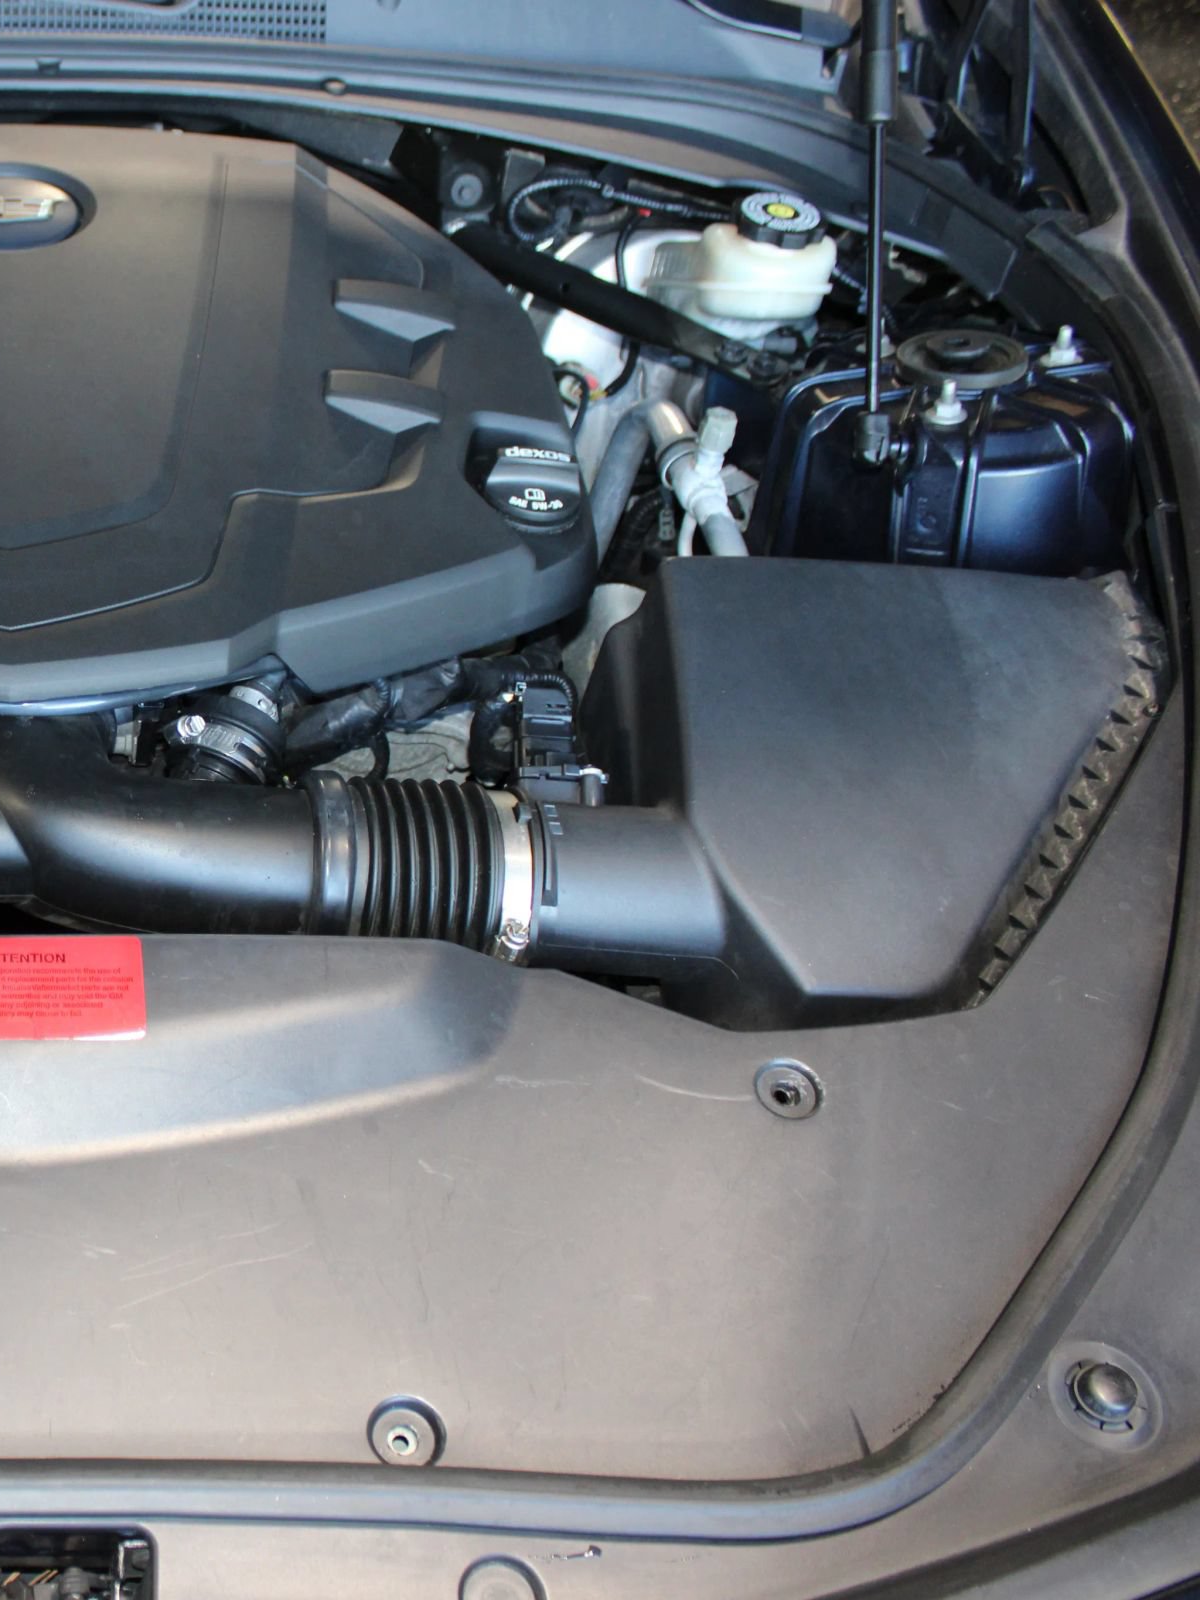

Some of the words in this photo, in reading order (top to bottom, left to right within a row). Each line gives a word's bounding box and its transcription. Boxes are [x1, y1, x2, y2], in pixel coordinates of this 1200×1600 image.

[505, 446, 570, 462] dexos
[509, 496, 528, 508] SAE
[109, 993, 123, 1001] GM
